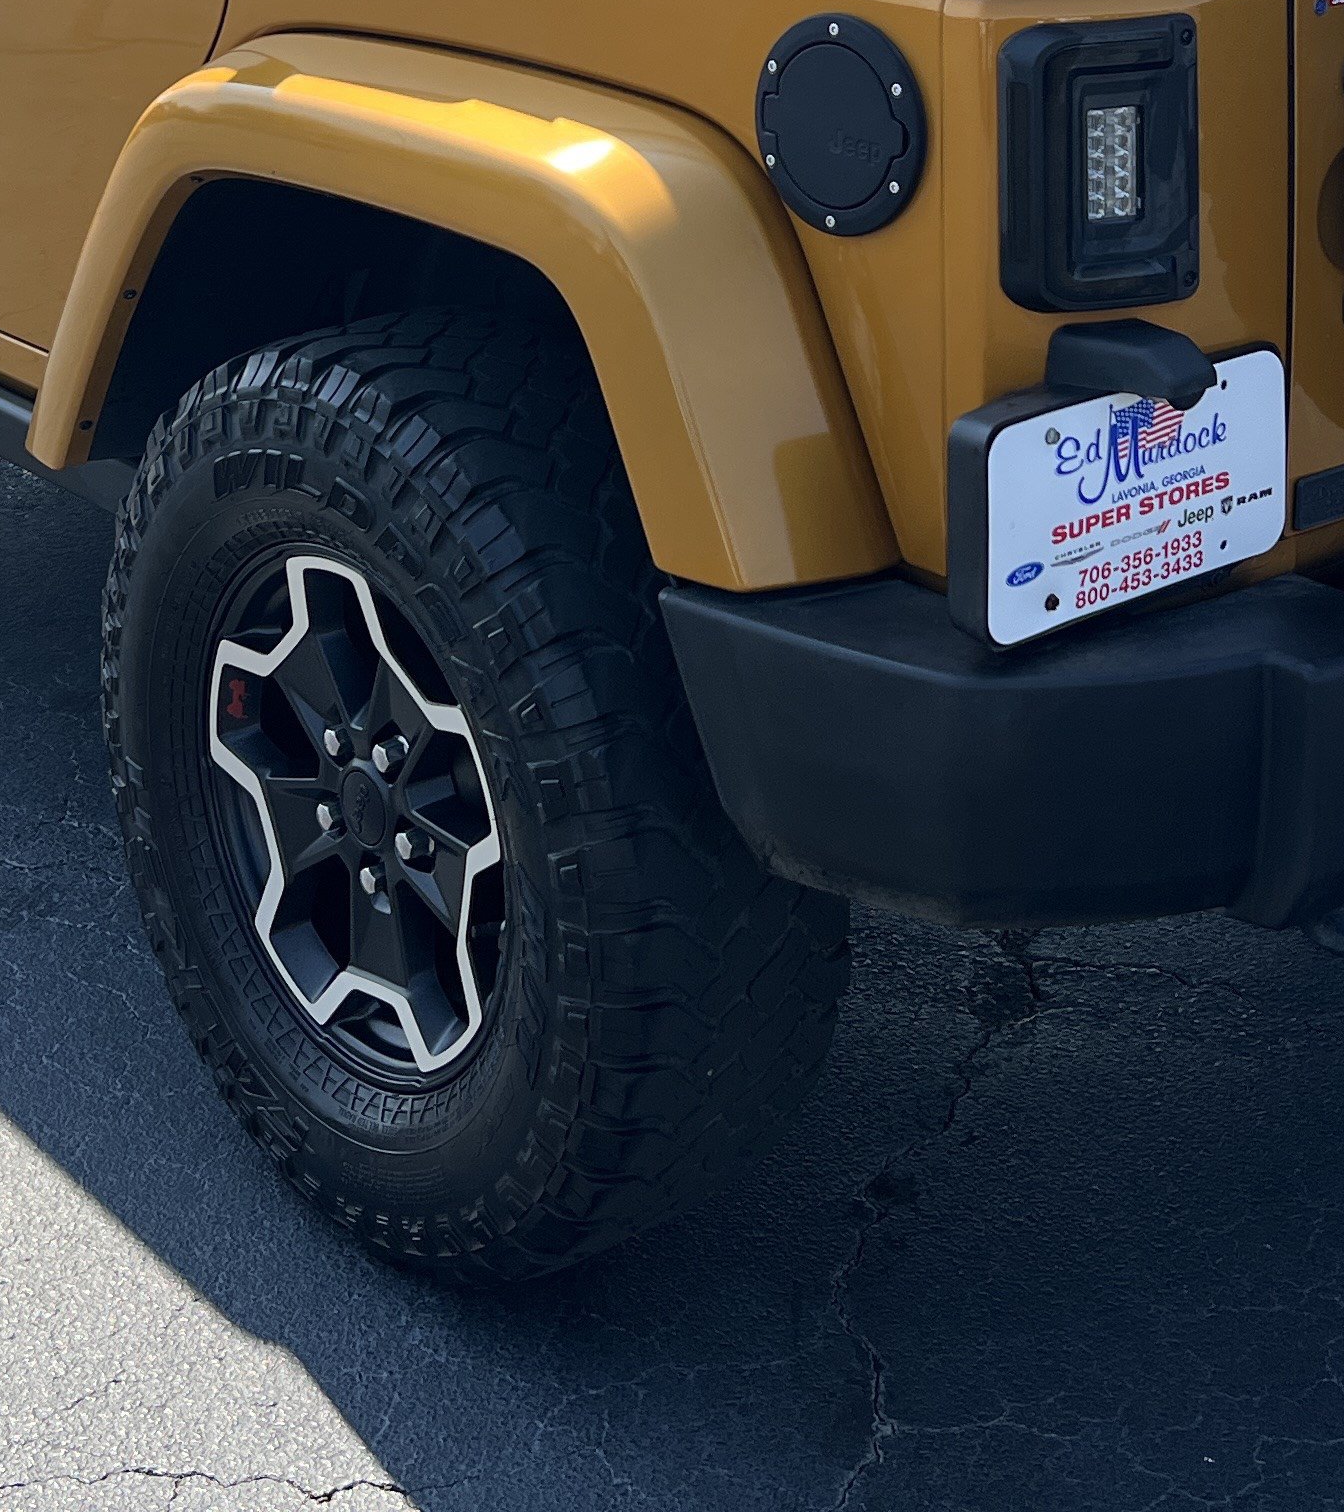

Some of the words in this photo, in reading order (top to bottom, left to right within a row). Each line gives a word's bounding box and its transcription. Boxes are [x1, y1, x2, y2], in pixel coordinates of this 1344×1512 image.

[827, 126, 884, 165] Jeep
[1055, 427, 1103, 476] Ed
[1077, 412, 1228, 505] Murdock
[1050, 502, 1131, 545] SUPER
[1138, 471, 1231, 517] STORES
[1111, 480, 1159, 504] LAVONIA,
[1161, 464, 1207, 488] GEORGIA
[1010, 563, 1040, 585] Ford
[1177, 505, 1214, 529] Jeep
[1236, 487, 1273, 506] RAM
[1078, 530, 1203, 588] 706-356-1933
[1075, 551, 1204, 609] 800-453-3433
